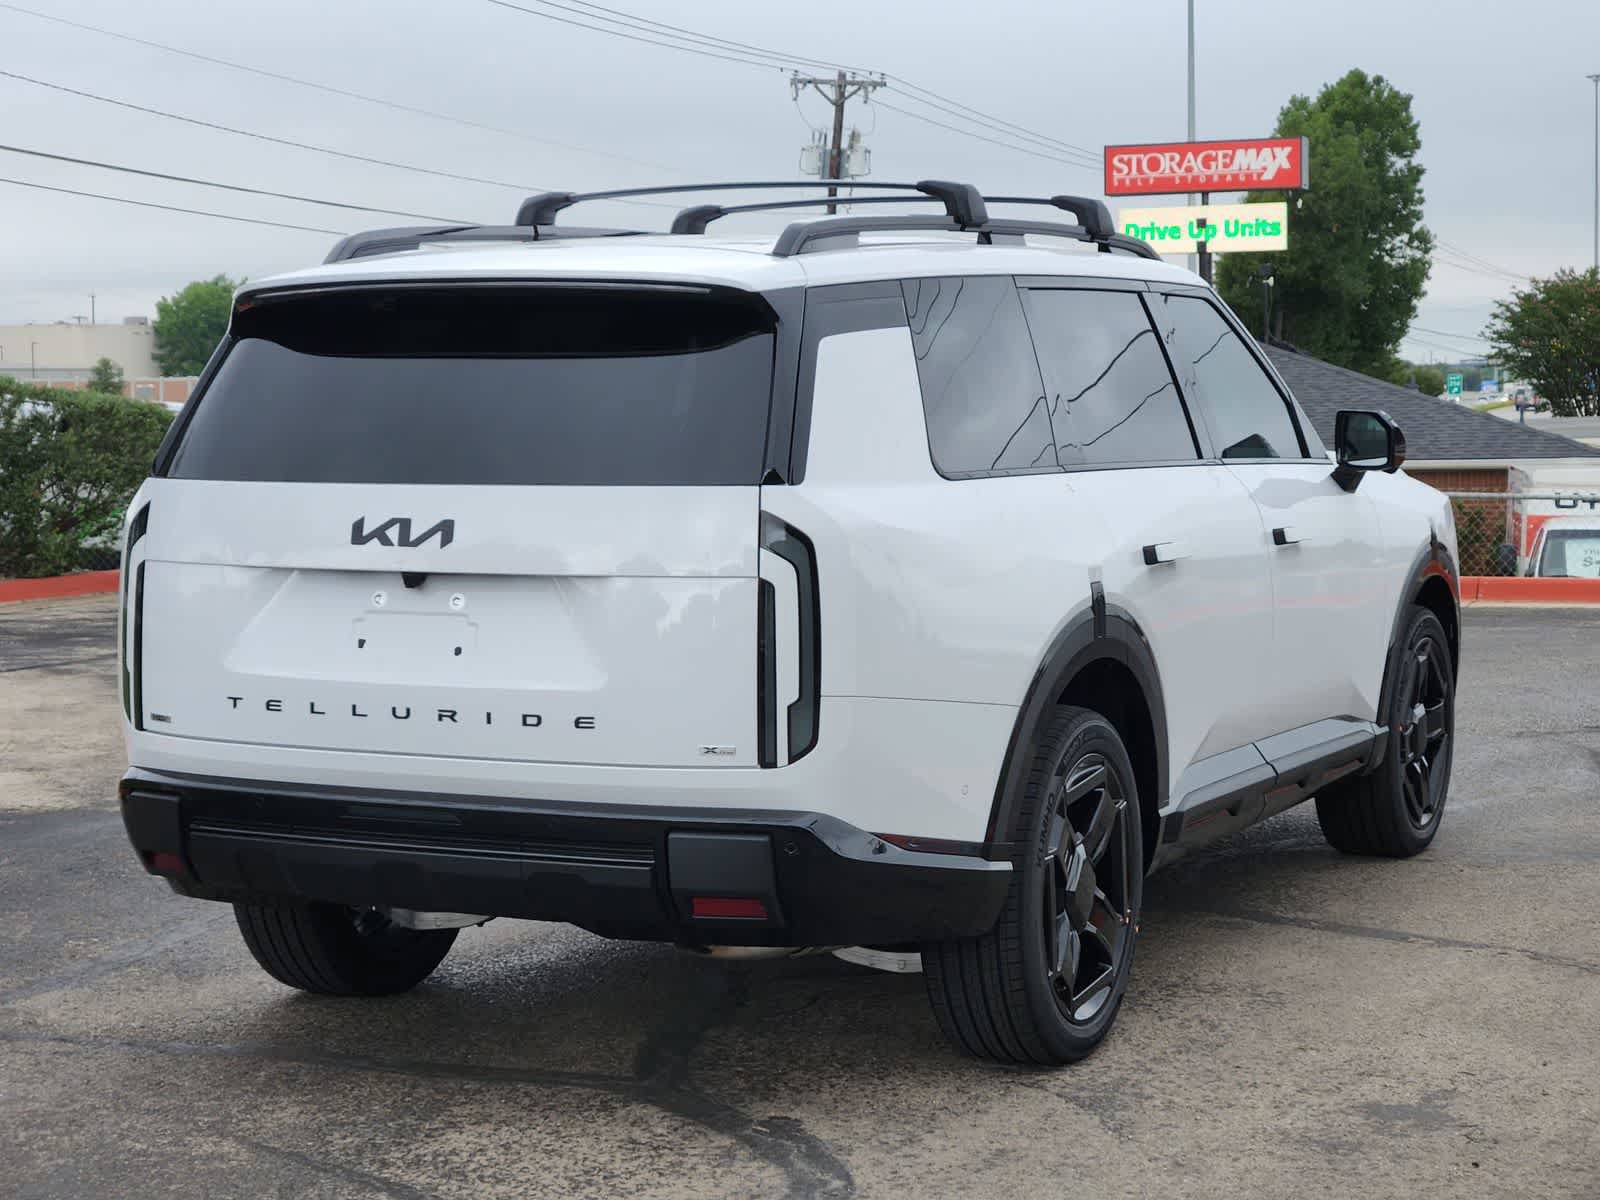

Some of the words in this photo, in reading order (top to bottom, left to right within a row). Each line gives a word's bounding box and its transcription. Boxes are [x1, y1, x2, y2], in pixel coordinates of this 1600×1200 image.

[1112, 146, 1293, 180] STORAGEMAX
[1125, 222, 1182, 240] Drive
[1188, 220, 1217, 242] Up
[1224, 218, 1281, 237] Units
[351, 516, 455, 549] KIA
[226, 696, 597, 730] TELLURIDE
